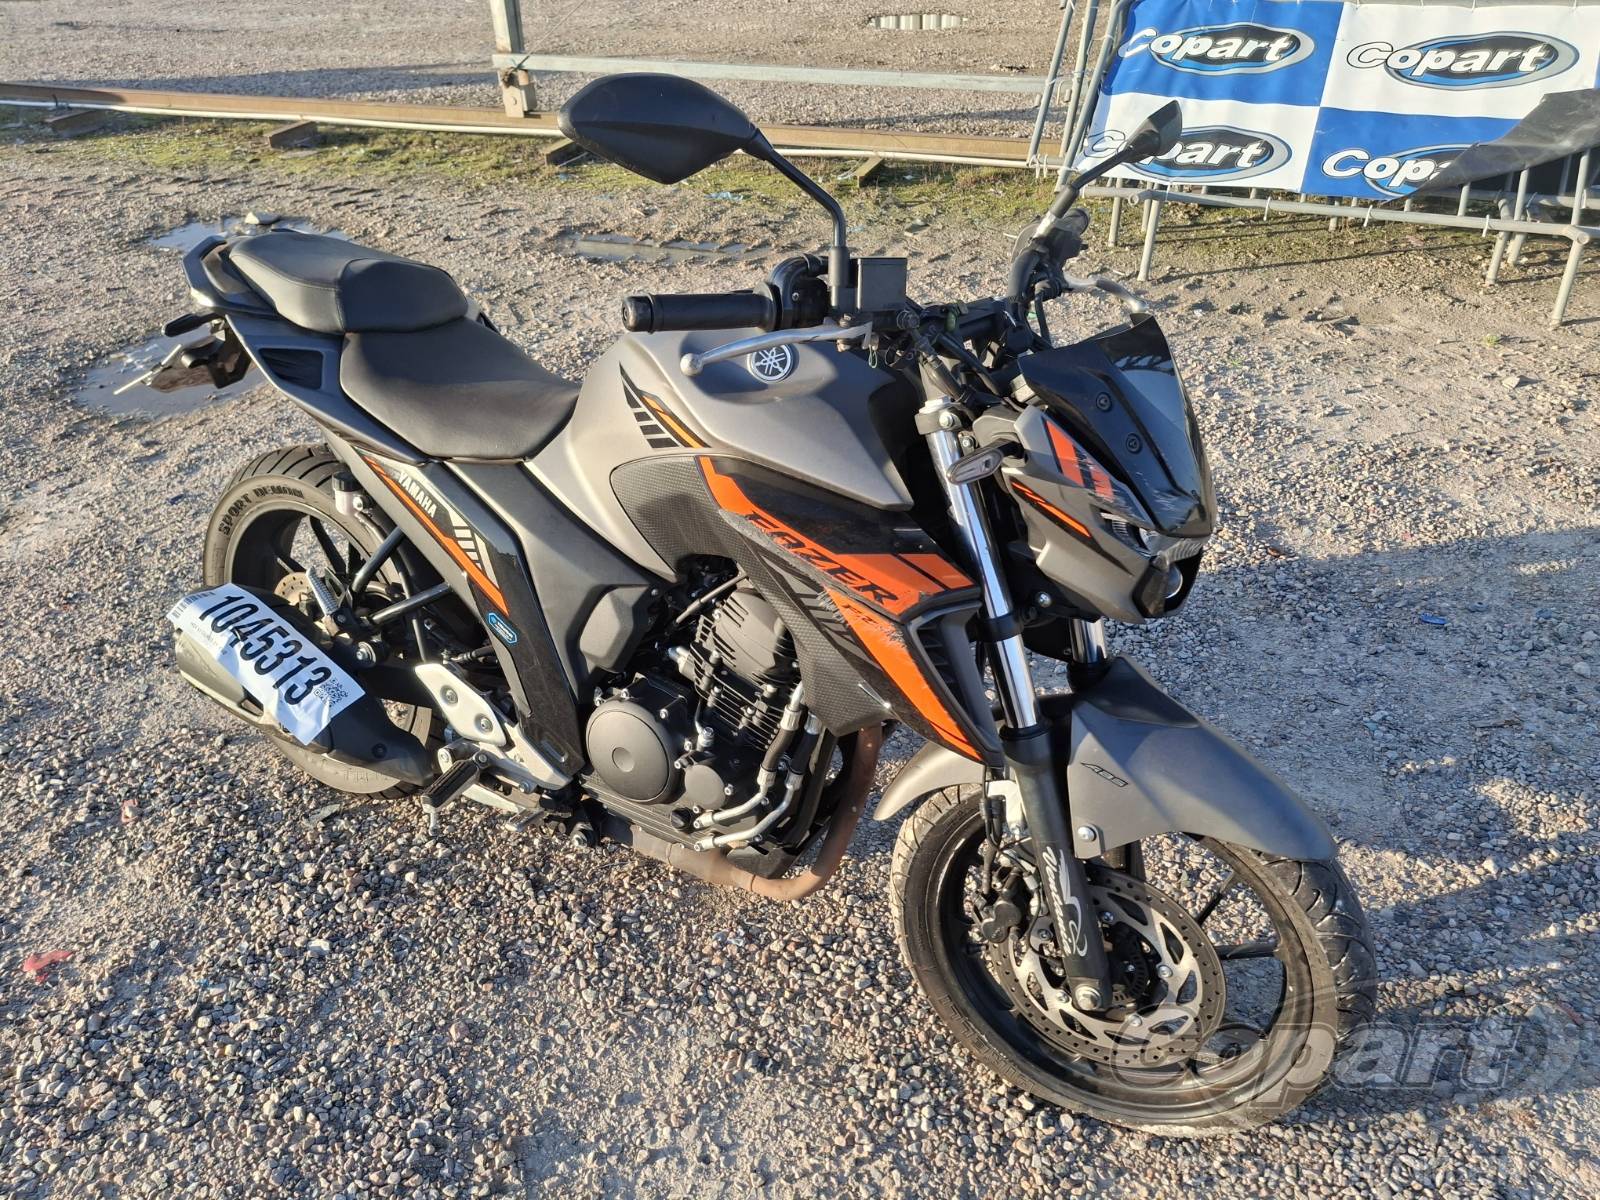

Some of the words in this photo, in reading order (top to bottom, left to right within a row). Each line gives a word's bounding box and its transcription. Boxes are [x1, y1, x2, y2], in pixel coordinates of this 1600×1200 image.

[1118, 28, 1292, 61] Copart
[1346, 41, 1550, 77] Copart
[1084, 130, 1267, 168] Cart
[218, 493, 252, 535] SPORT
[398, 471, 437, 518] YAMAHA
[745, 510, 899, 605] FAZER
[198, 595, 332, 705] 1045313
